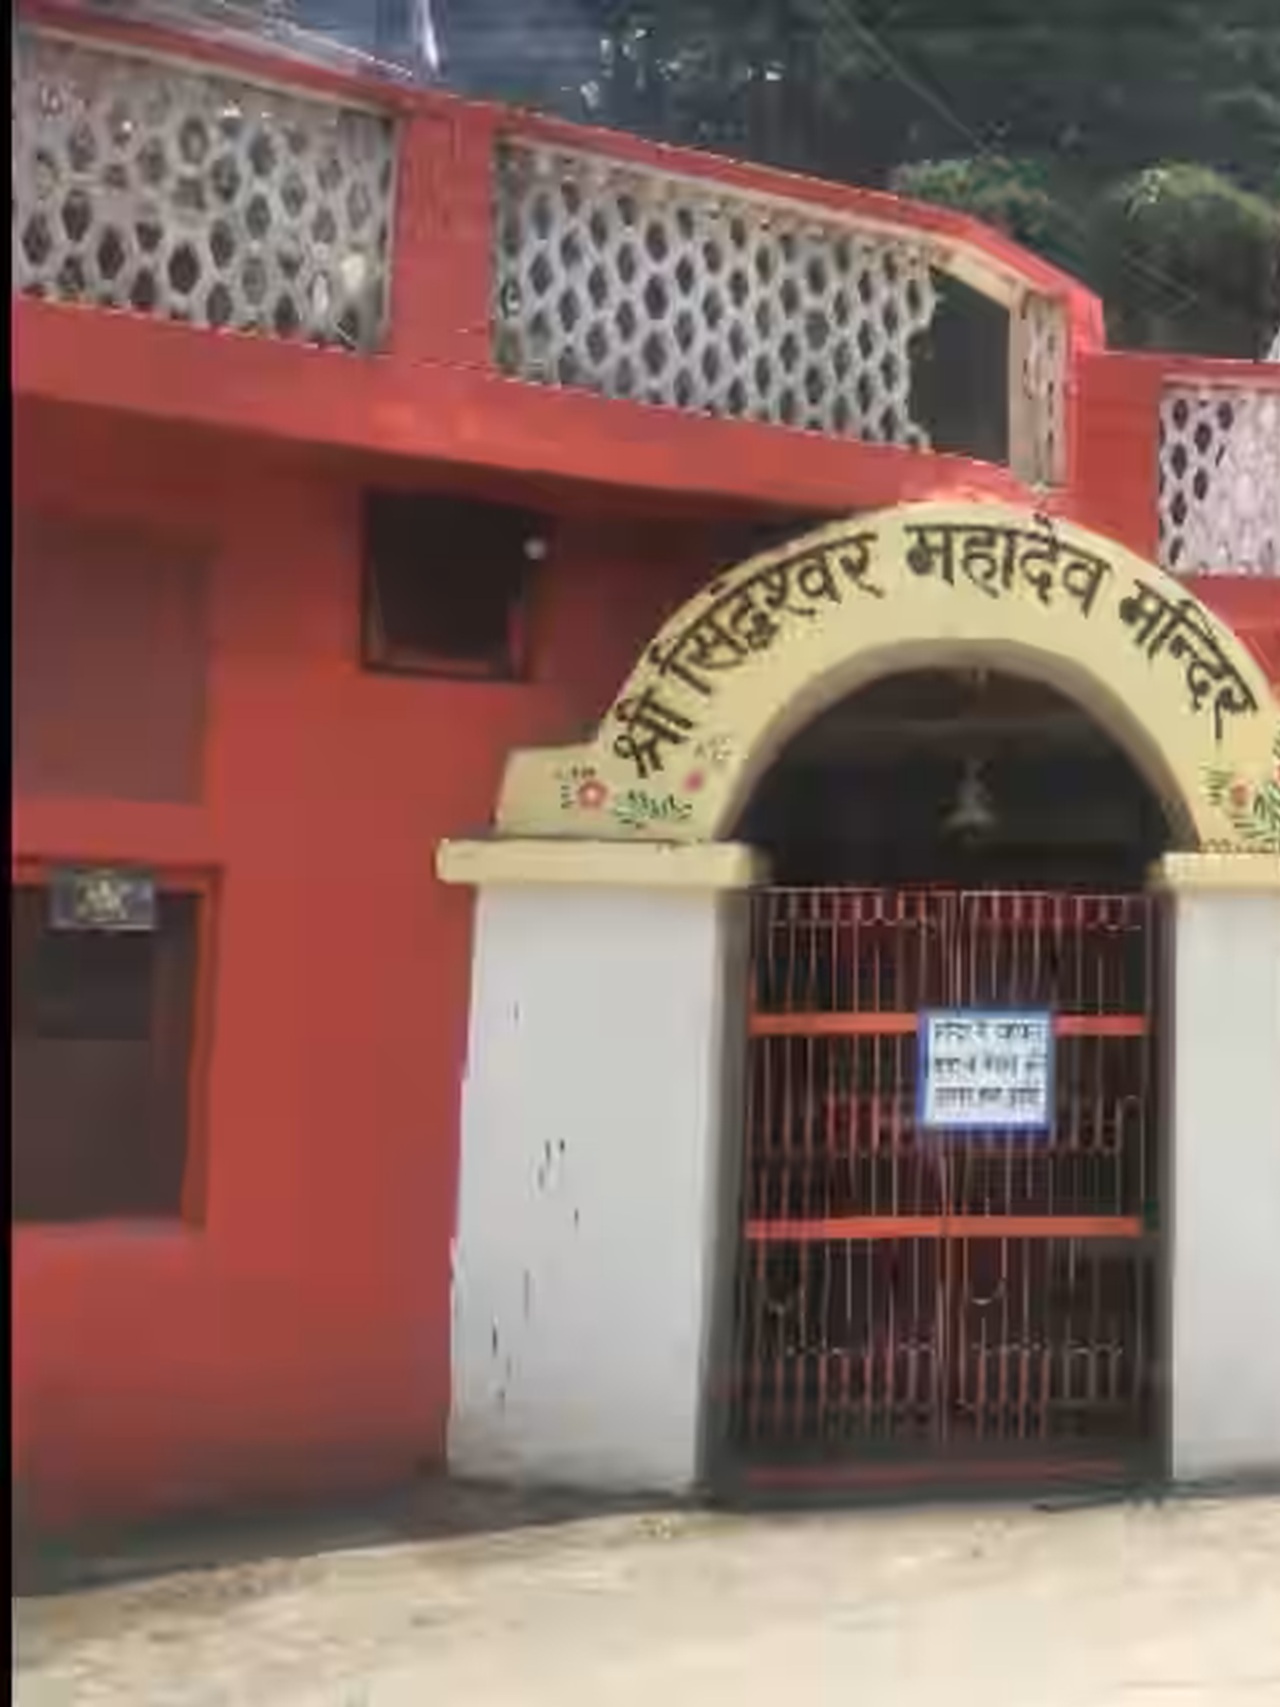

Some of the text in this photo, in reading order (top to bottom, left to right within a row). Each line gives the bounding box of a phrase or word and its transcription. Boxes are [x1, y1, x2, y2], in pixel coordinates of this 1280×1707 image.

[613, 686, 694, 779] श्री
[904, 512, 1113, 619] महादेव
[1119, 578, 1259, 741] मन्दिर
